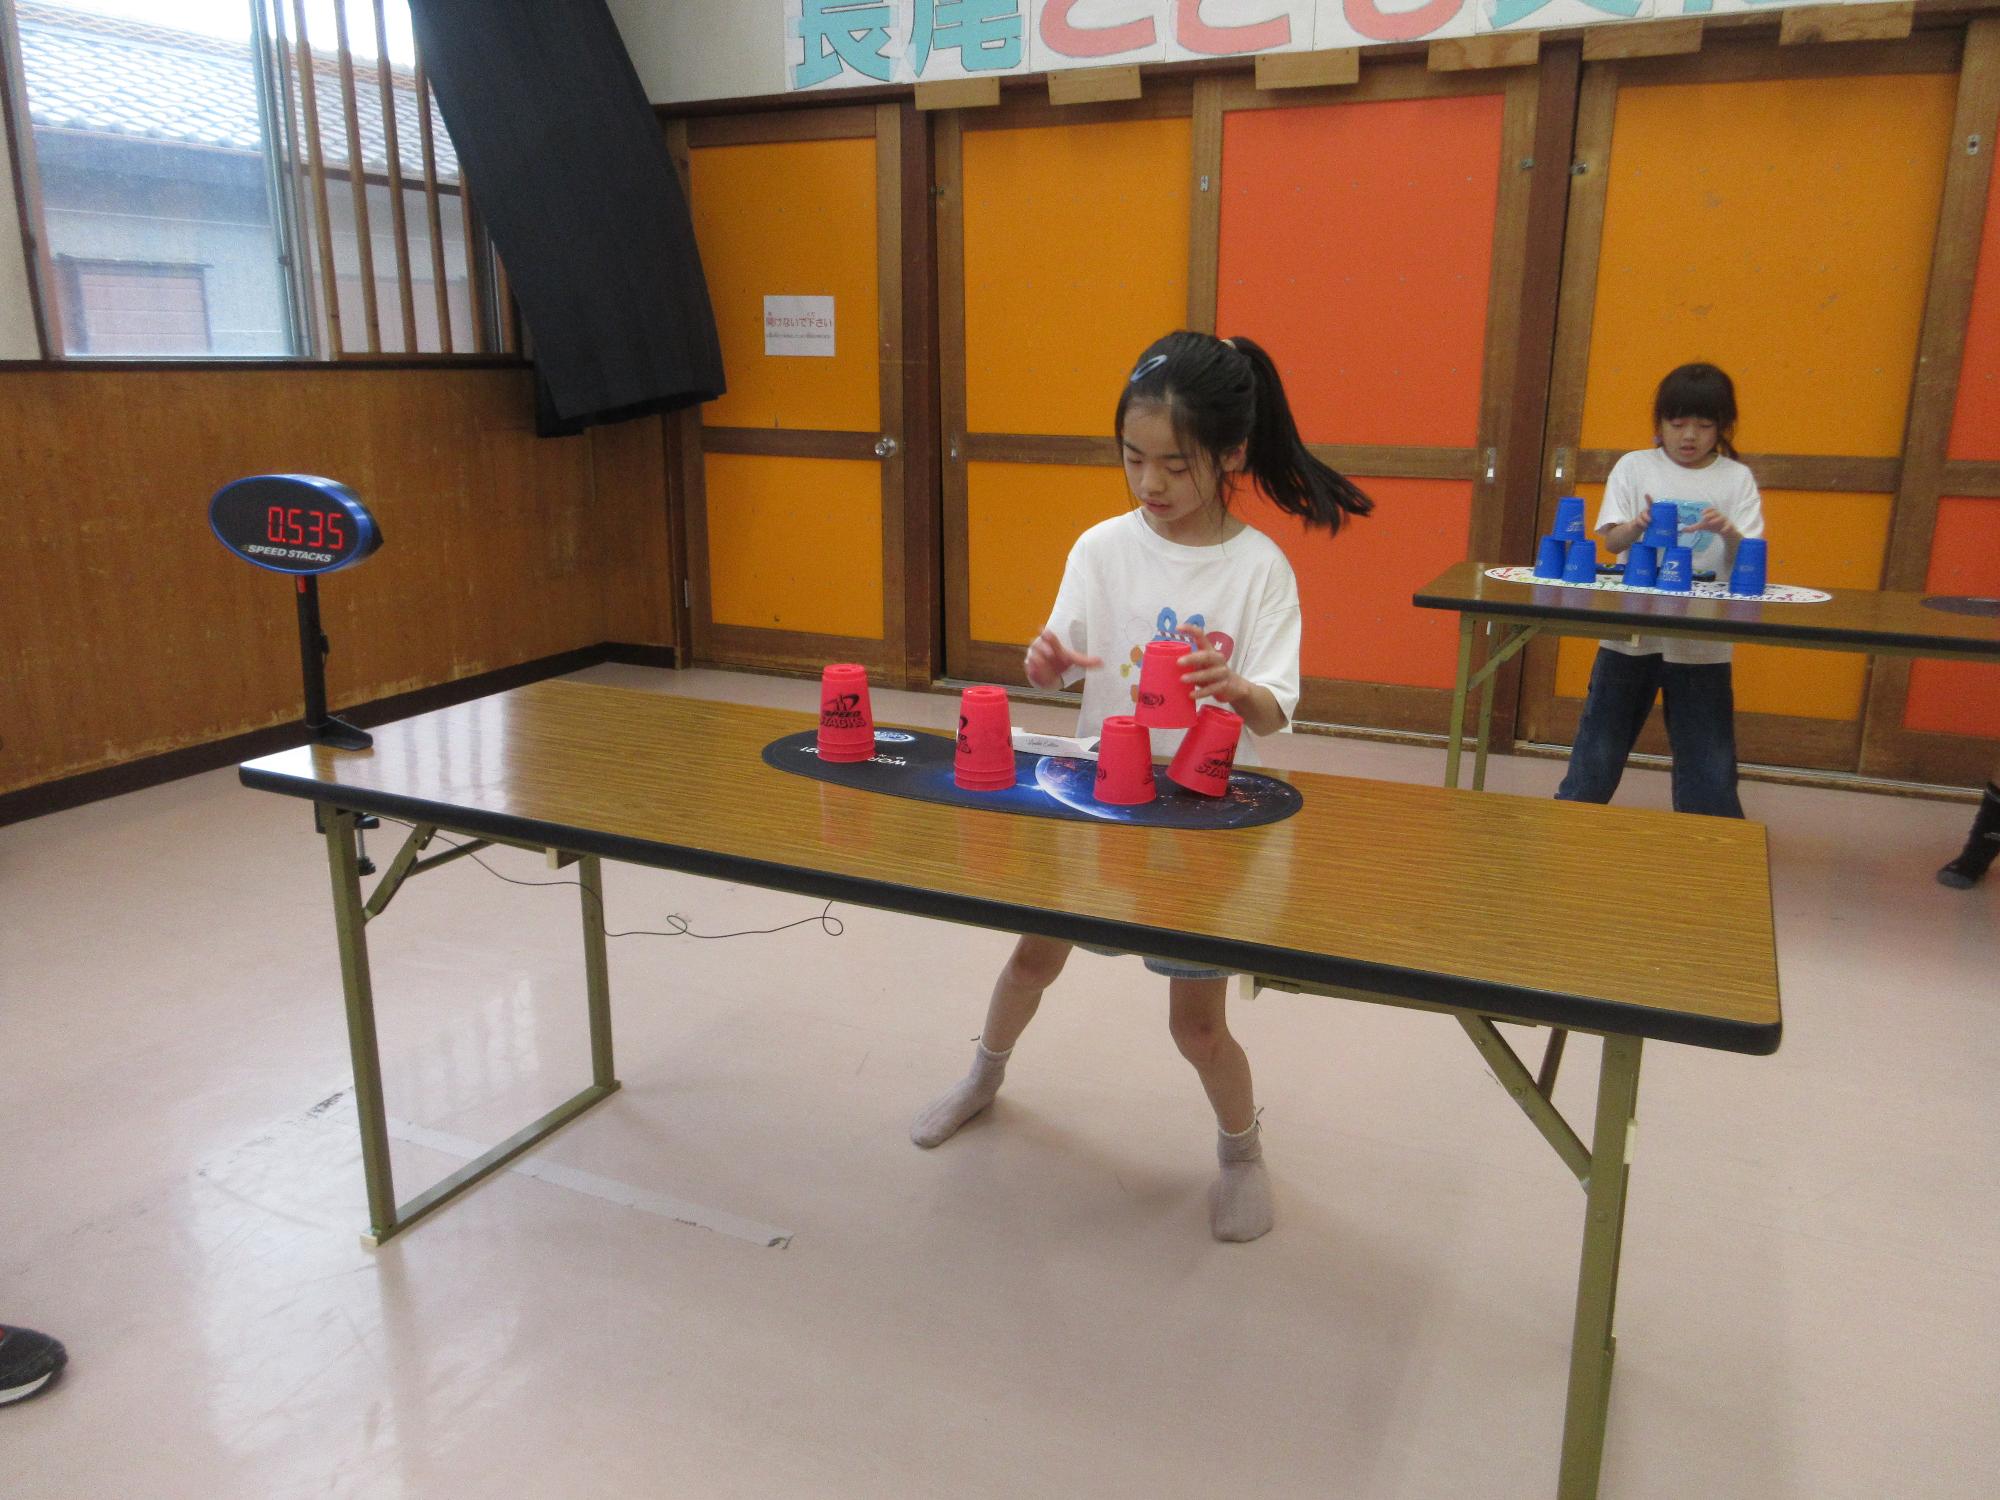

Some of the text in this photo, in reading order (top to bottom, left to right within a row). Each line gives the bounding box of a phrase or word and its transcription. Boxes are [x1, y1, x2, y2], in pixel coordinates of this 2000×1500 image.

[267, 506, 344, 550] 0.535
[248, 544, 332, 563] SPEED STACKS
